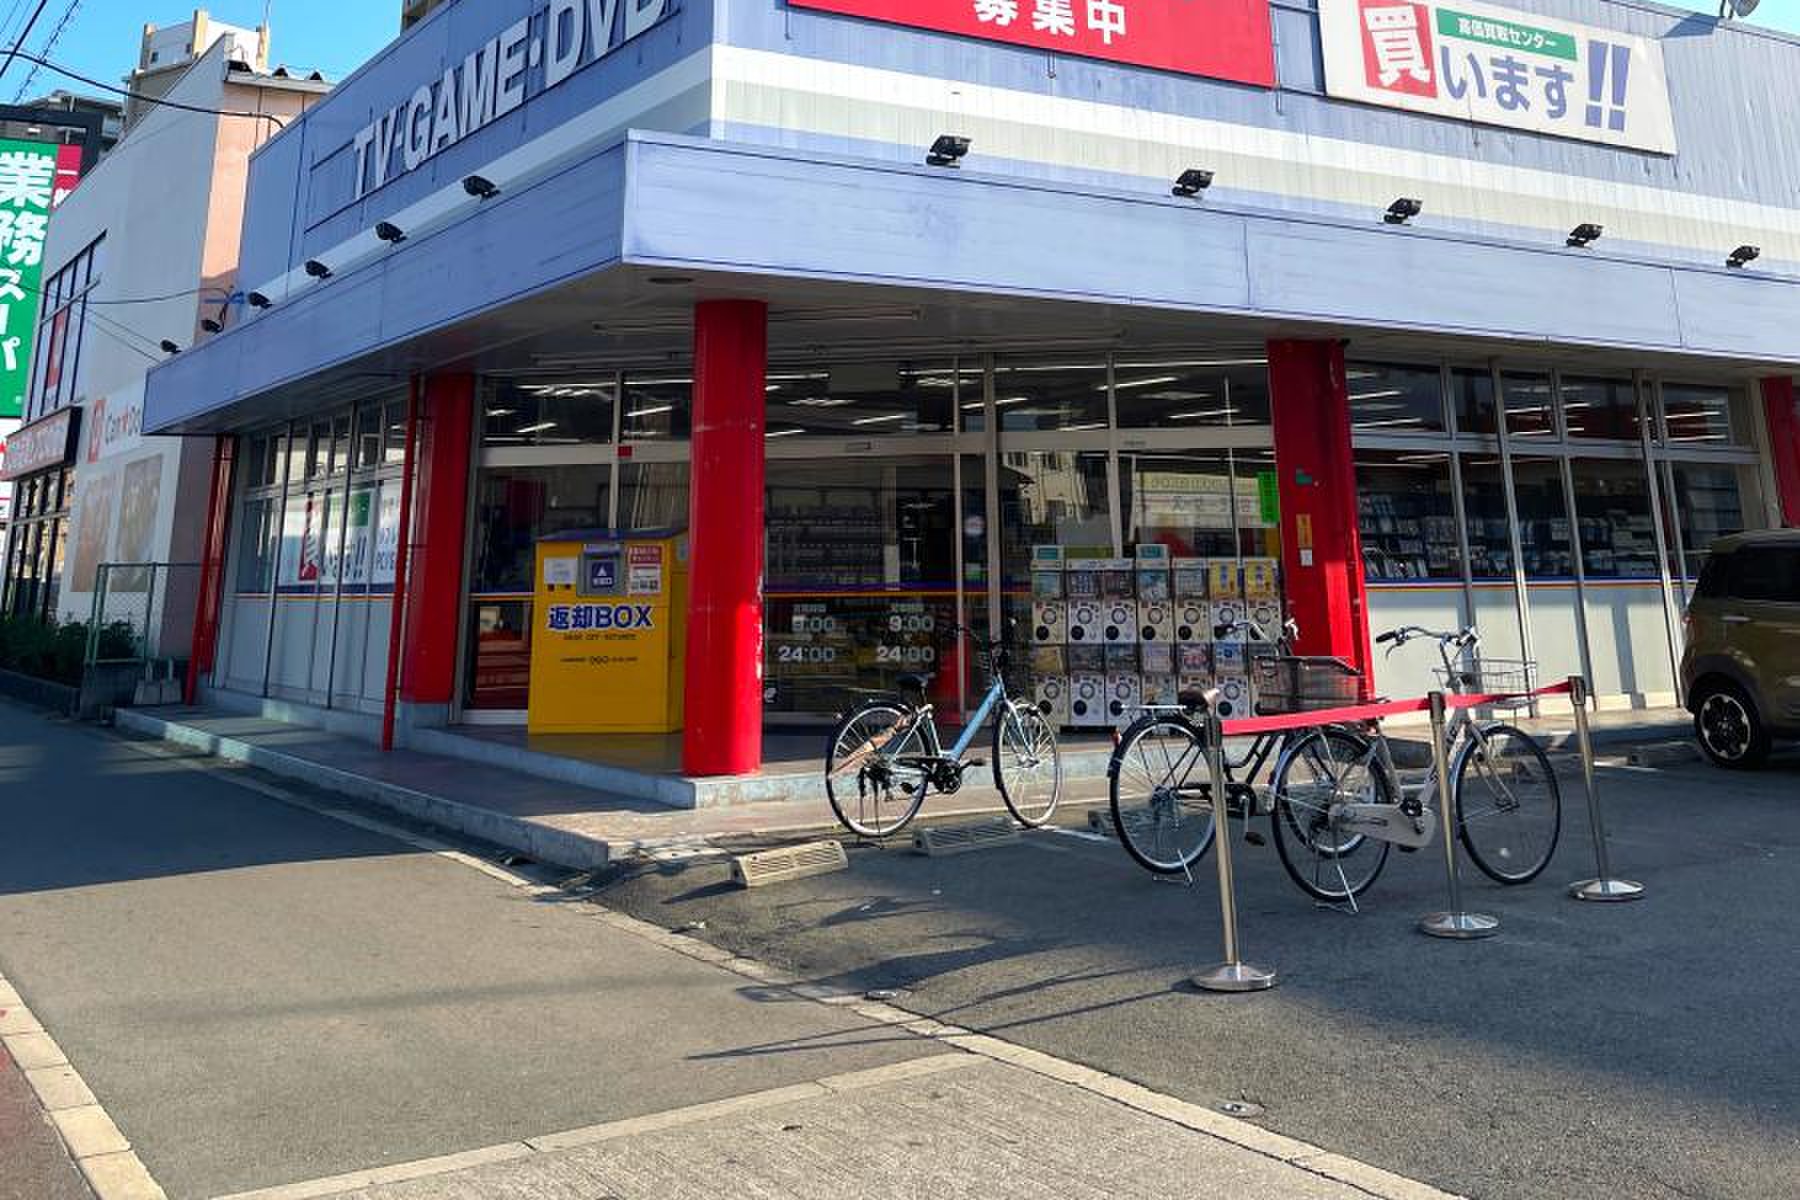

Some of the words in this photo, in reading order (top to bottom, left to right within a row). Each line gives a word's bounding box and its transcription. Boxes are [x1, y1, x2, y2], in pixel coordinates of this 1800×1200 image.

[547, 604, 655, 631] 返却BOX
[888, 615, 935, 633] 9:00
[777, 645, 835, 663] 24:00
[876, 645, 935, 663] 24:00
